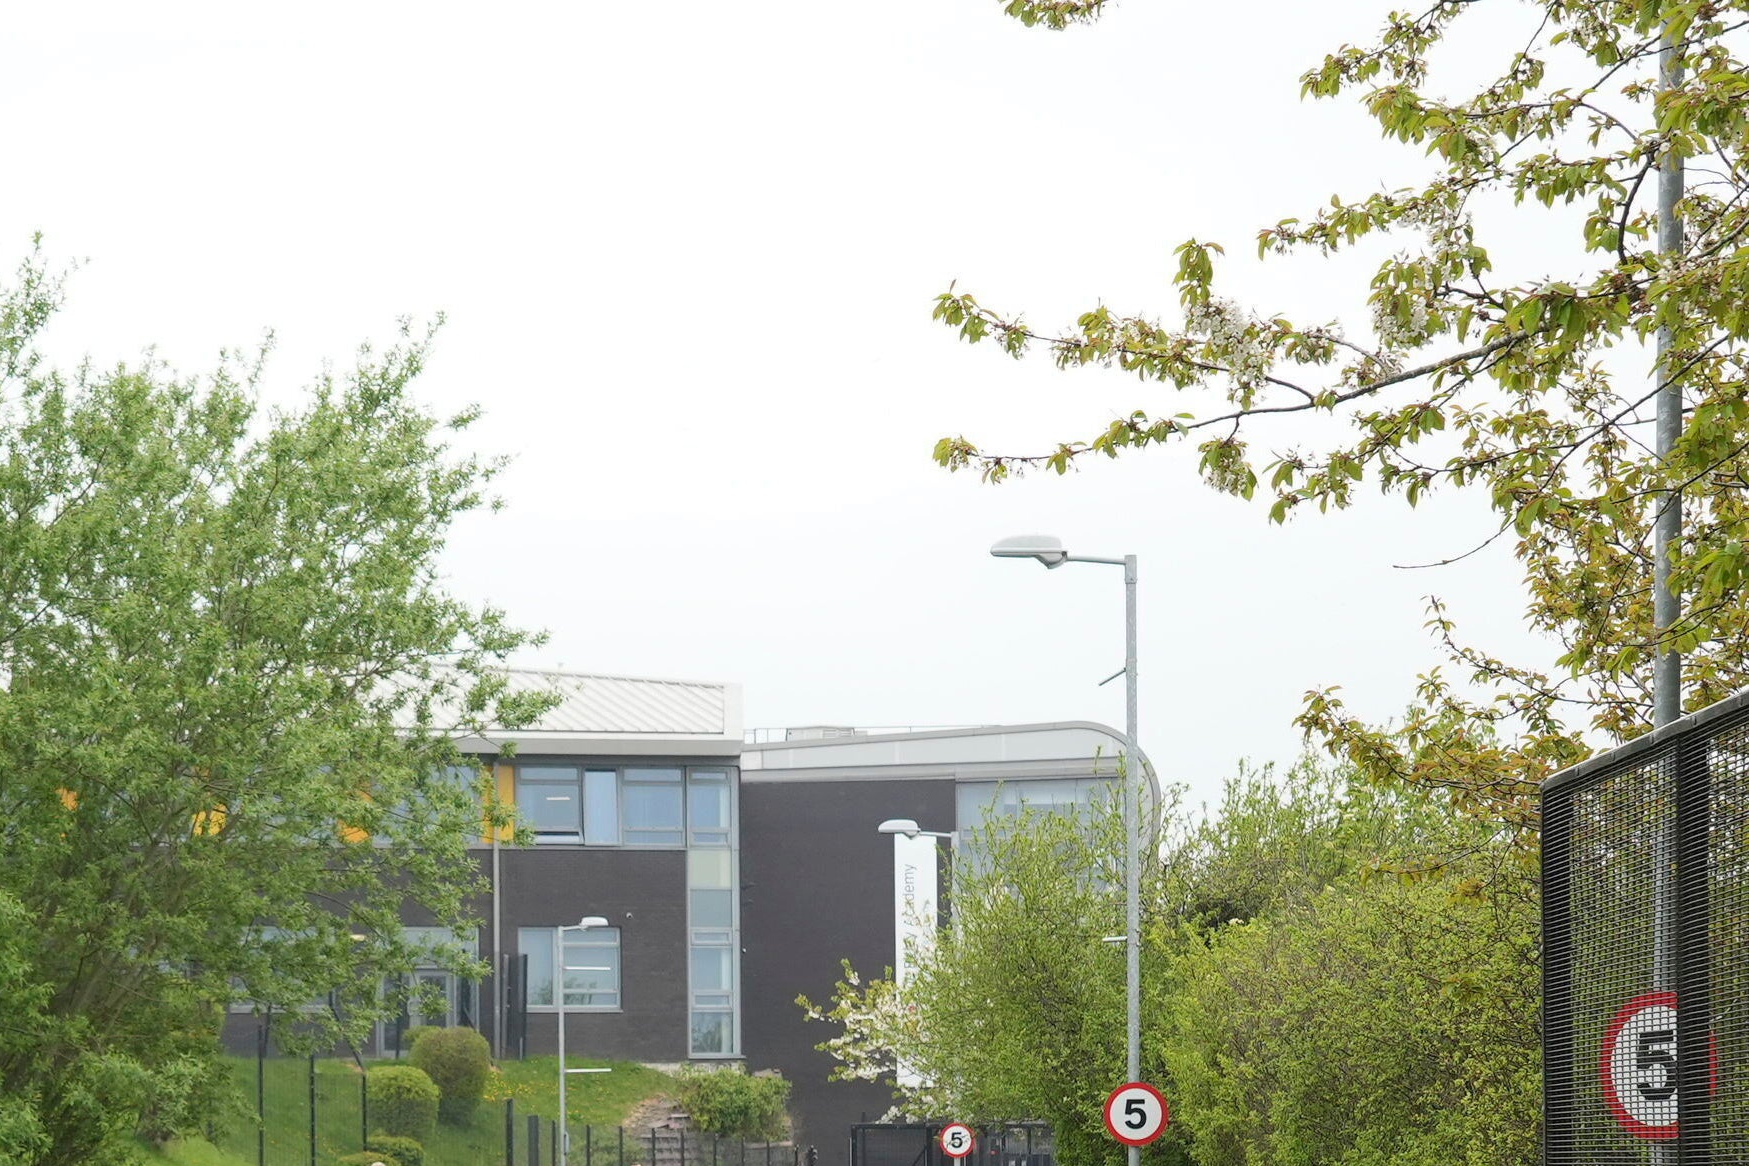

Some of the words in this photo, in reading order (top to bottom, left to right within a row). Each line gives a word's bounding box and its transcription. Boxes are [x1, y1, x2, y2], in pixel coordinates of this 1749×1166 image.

[1636, 1029, 1678, 1101] 5
[1124, 1098, 1147, 1130] 5
[951, 1131, 963, 1149] 5
